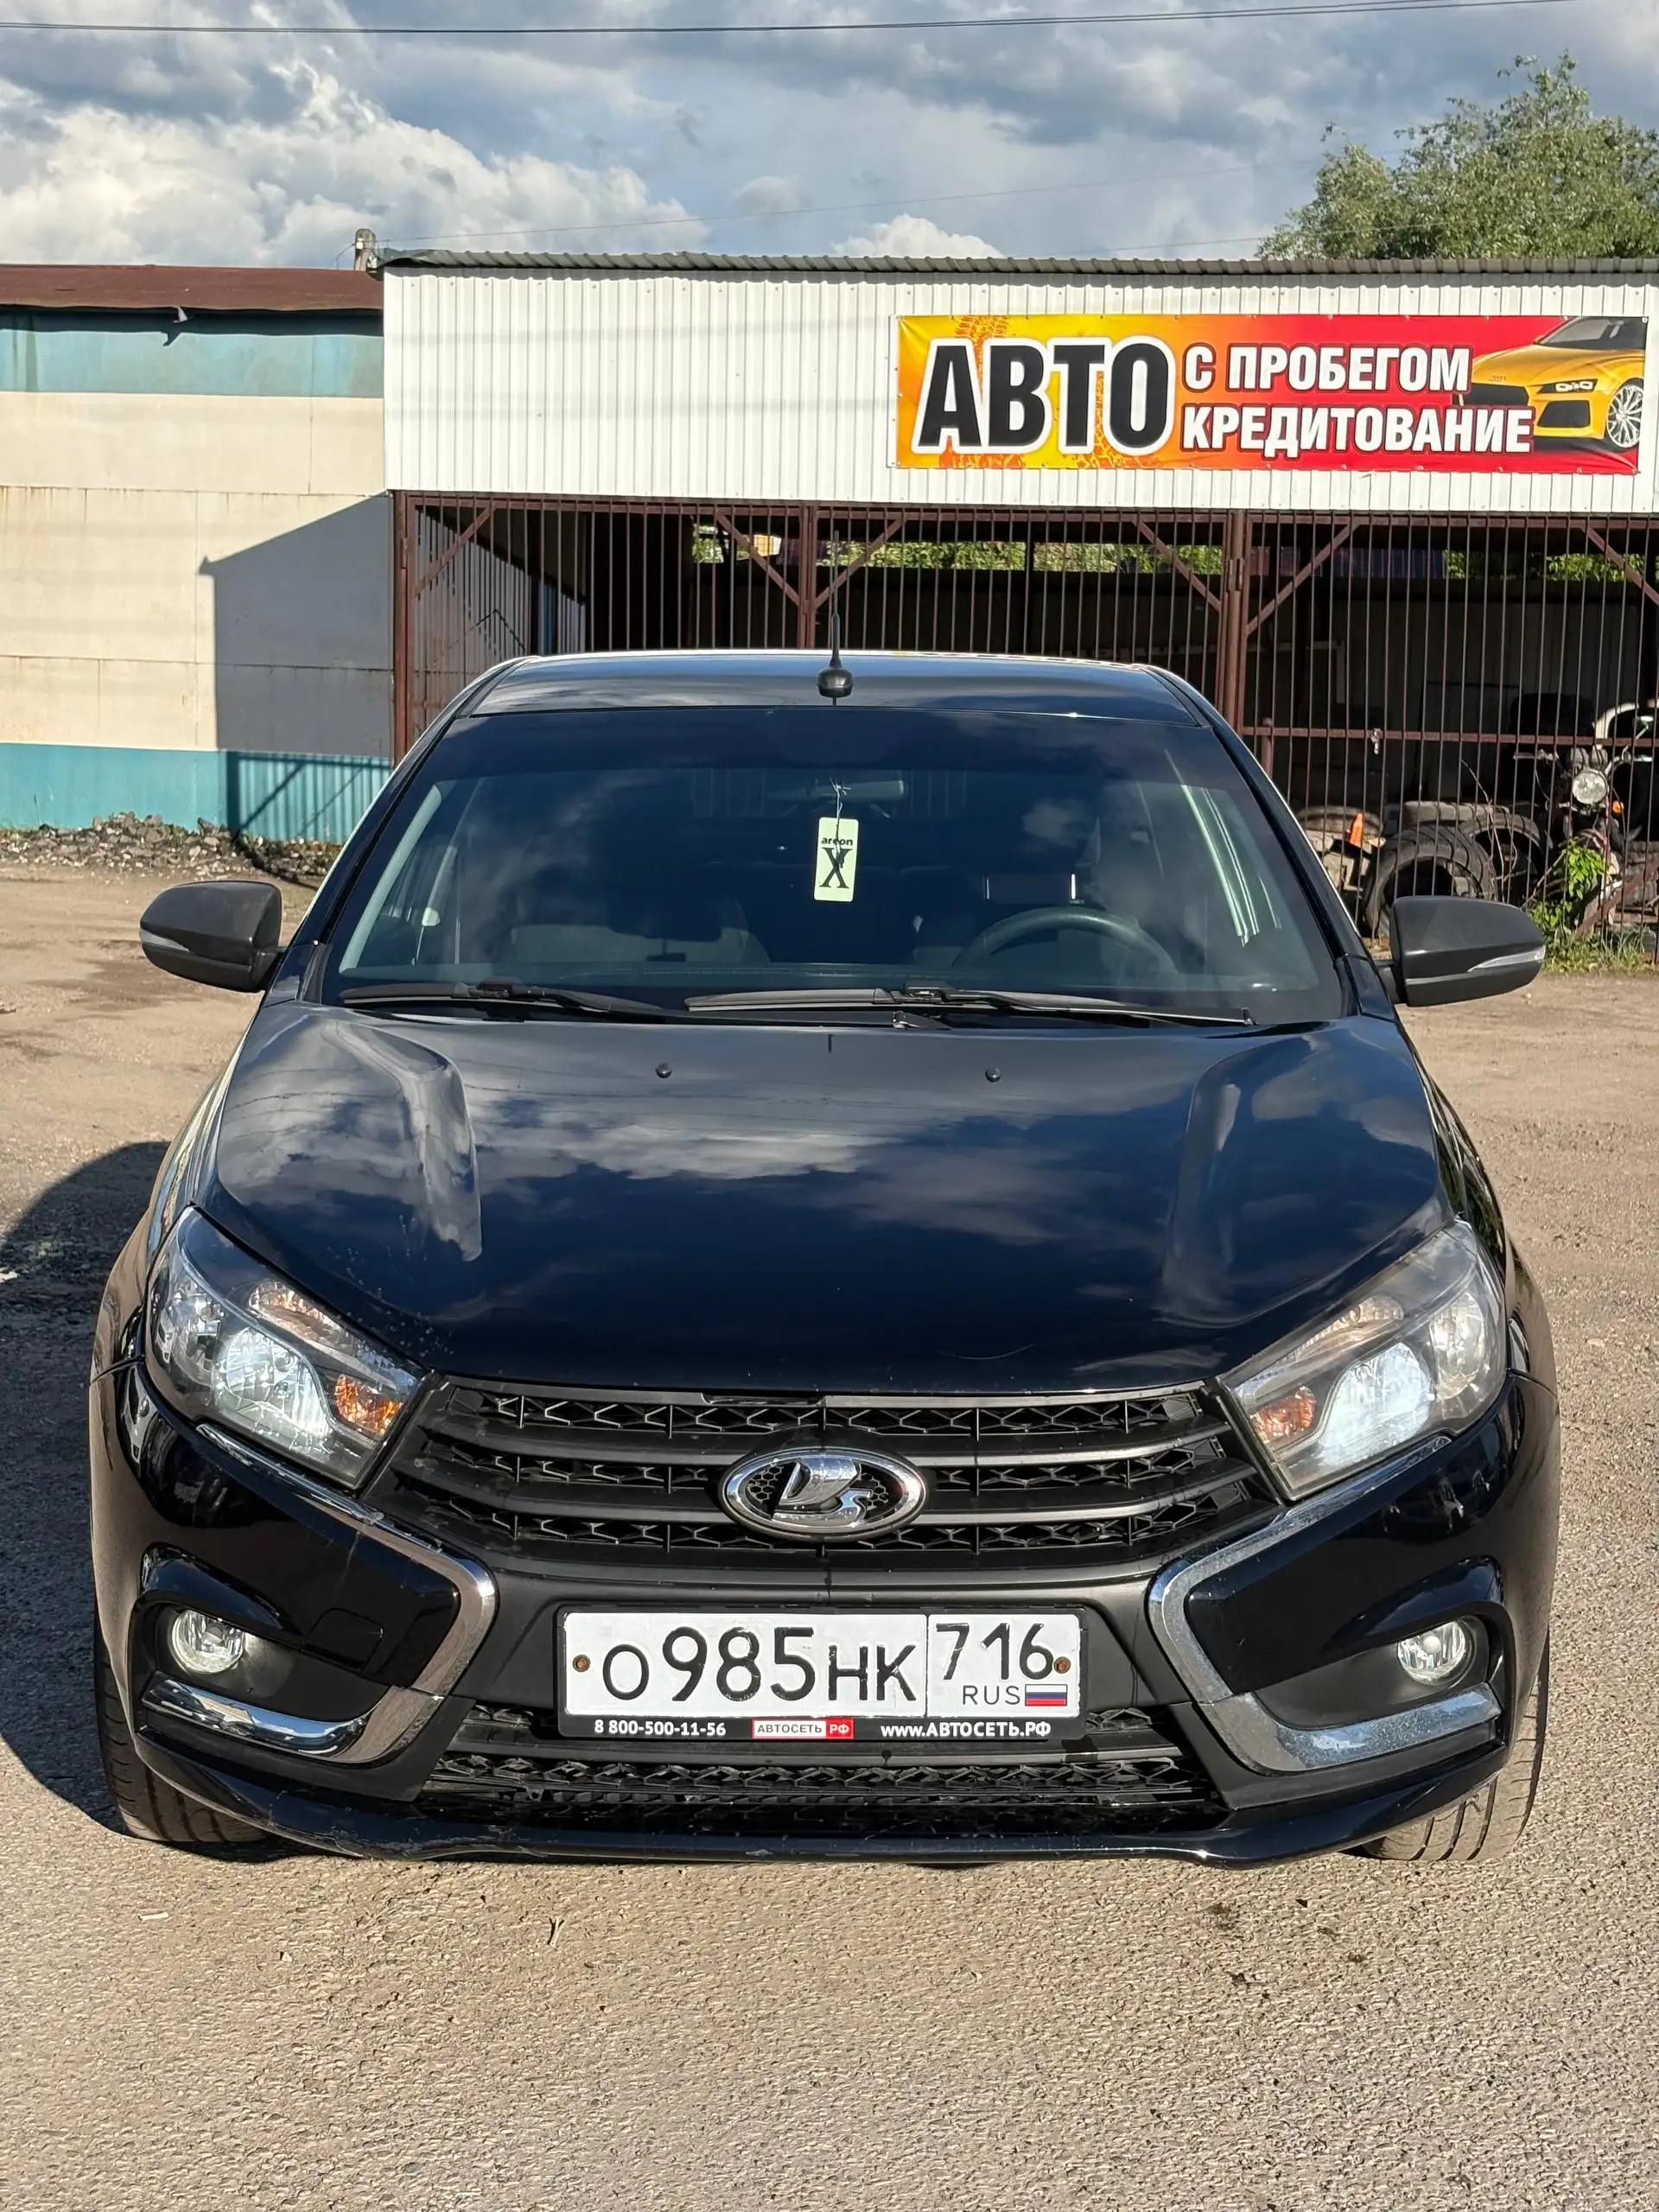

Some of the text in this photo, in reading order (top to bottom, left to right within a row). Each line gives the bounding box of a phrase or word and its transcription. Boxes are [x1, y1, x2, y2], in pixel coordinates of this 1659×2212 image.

[1185, 346, 1470, 391] С ПРОБЕГОМ
[918, 342, 1169, 448] АВТО
[1183, 406, 1532, 458] КРЕДИТОВАНИЕ
[821, 837, 854, 846] areon
[935, 1623, 1055, 1681] 716
[963, 1685, 1020, 1706] RUS
[594, 1719, 727, 1737] 8 800-500-11-56
[757, 1723, 849, 1735] АВТОСЕТЬ РФ
